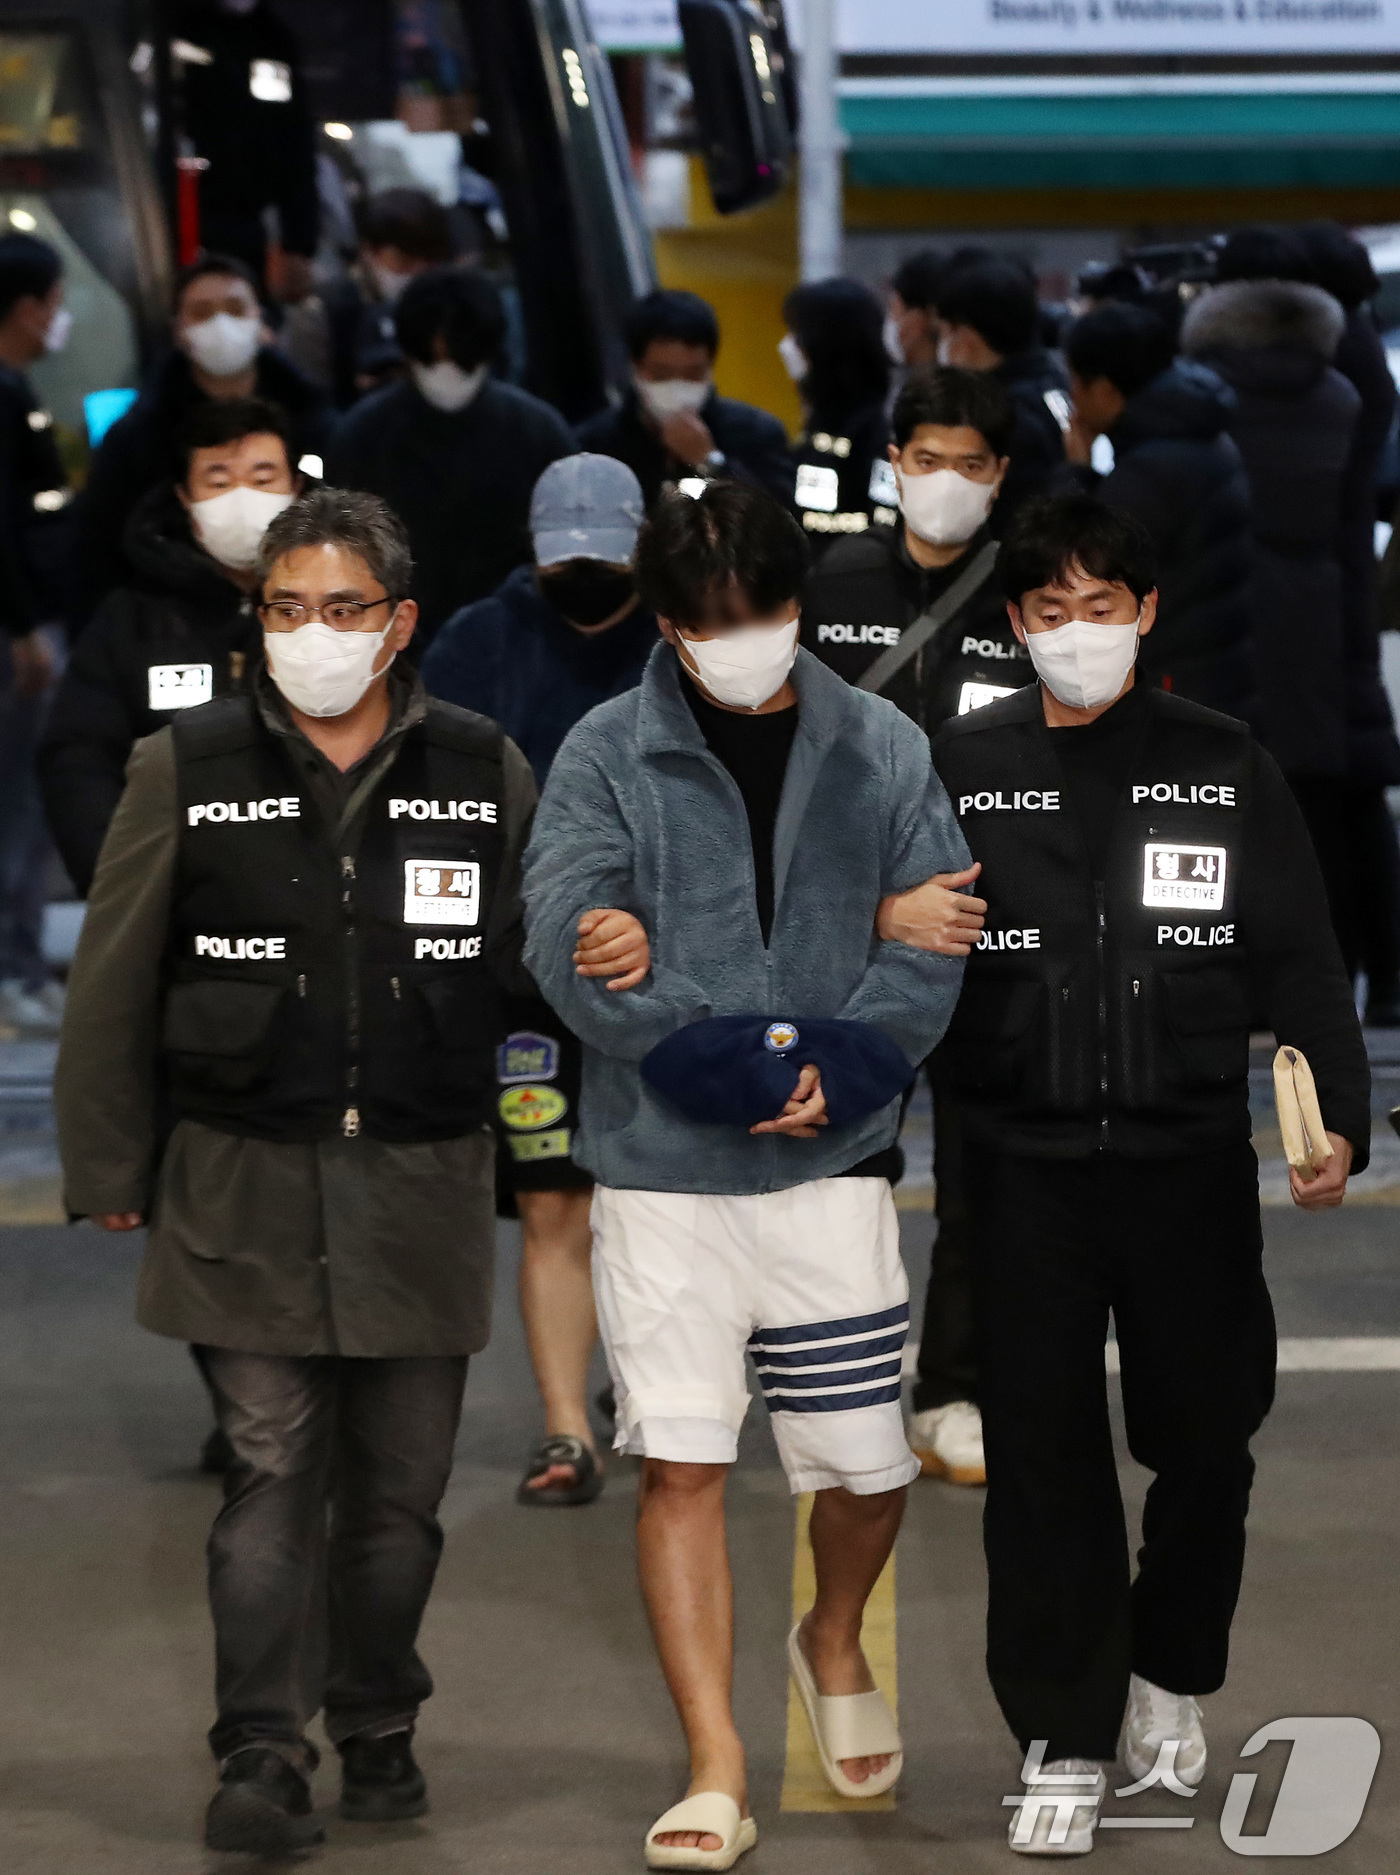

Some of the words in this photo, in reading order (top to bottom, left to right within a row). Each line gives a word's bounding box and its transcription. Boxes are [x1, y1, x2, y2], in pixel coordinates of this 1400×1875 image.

[818, 624, 900, 646] POLICE
[959, 791, 1060, 815] POLICE
[1132, 783, 1236, 807] POLICE
[188, 797, 301, 826] POLICE
[388, 798, 498, 823] POLICE
[1153, 885, 1216, 900] DETECTIVE
[975, 929, 1041, 950] OLICE
[1157, 924, 1235, 946] POLICE
[195, 935, 286, 960] POLICE
[414, 936, 482, 960] POLICE
